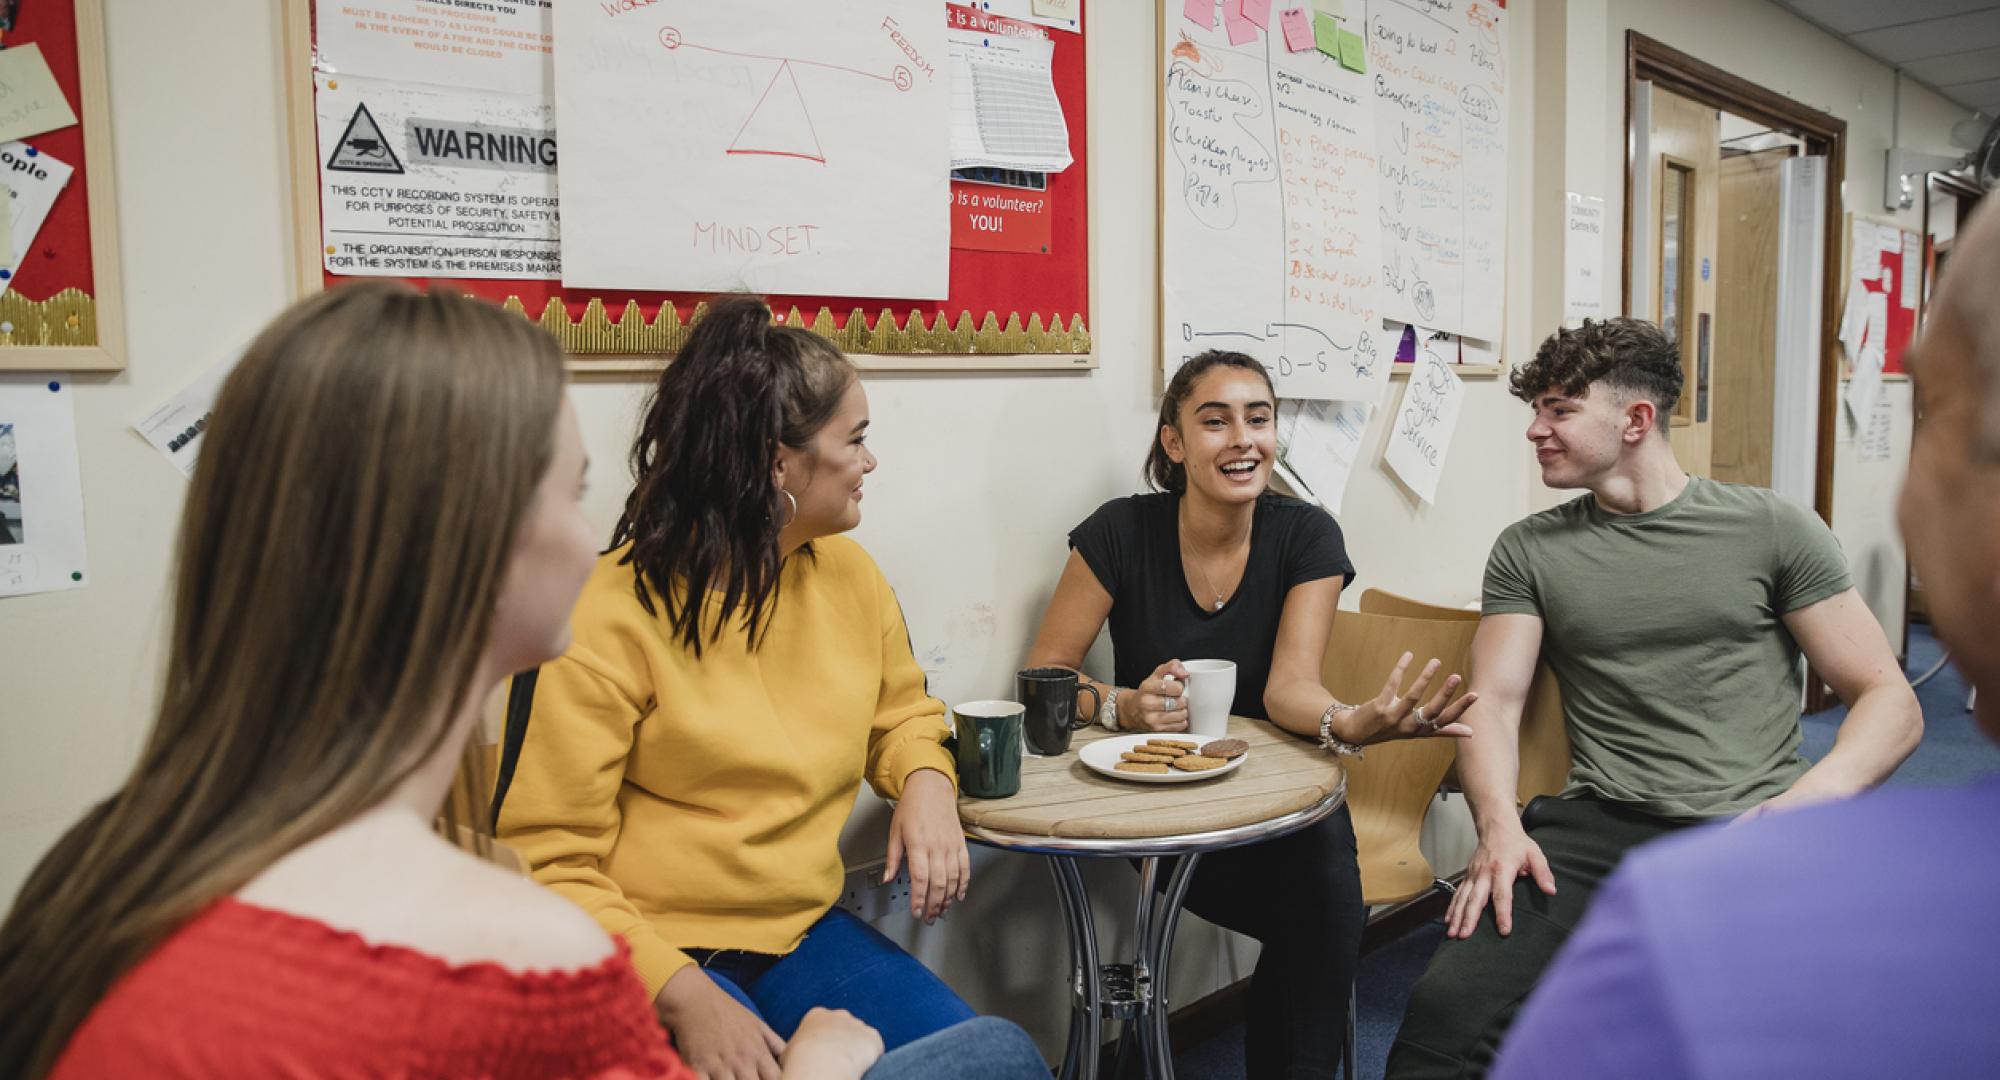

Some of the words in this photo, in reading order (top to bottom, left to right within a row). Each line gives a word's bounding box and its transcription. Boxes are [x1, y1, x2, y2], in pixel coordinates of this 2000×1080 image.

[416, 5, 438, 14] THIS
[442, 9, 496, 23] PROCEDURE
[454, 0, 494, 11] DIRECTS
[497, 5, 516, 15] YOU
[342, 7, 371, 17] MUST
[375, 11, 387, 19] BE
[391, 14, 430, 25] ADHERE
[434, 20, 446, 28] TO
[449, 22, 460, 30] AS
[464, 24, 490, 34] LIVES
[493, 28, 524, 38] COULD
[956, 9, 966, 25] is
[970, 15, 977, 27] a
[355, 21, 367, 30] IN
[370, 23, 389, 33] THE
[392, 26, 424, 37] EVENT
[428, 30, 441, 39] OF
[452, 34, 473, 44] FIRE
[476, 38, 495, 47] AND
[499, 40, 516, 49] THE
[414, 42, 448, 52] WOULD
[452, 46, 463, 54] BE
[466, 47, 503, 58] CLOSED
[414, 127, 557, 166] WARNING
[330, 185, 356, 196] THIS
[361, 187, 393, 198] CCTV
[397, 189, 460, 202] RECORDING
[464, 193, 504, 204] SYSTEM
[508, 196, 517, 205] IS
[958, 190, 968, 206] is
[971, 195, 979, 207] a
[982, 195, 1044, 213] volunteer?
[345, 201, 370, 211] FOR
[374, 202, 433, 215] PURPOSES
[437, 206, 451, 215] OF
[512, 209, 550, 220] SAFETY
[388, 217, 448, 229] POTENTIAL
[969, 213, 1003, 232] YOU!
[343, 243, 365, 254] THE
[329, 257, 353, 267] FOR
[358, 257, 380, 268] THE
[384, 258, 428, 269] SYSTEM
[445, 260, 466, 270] THE
[469, 261, 523, 272] PREMISES
